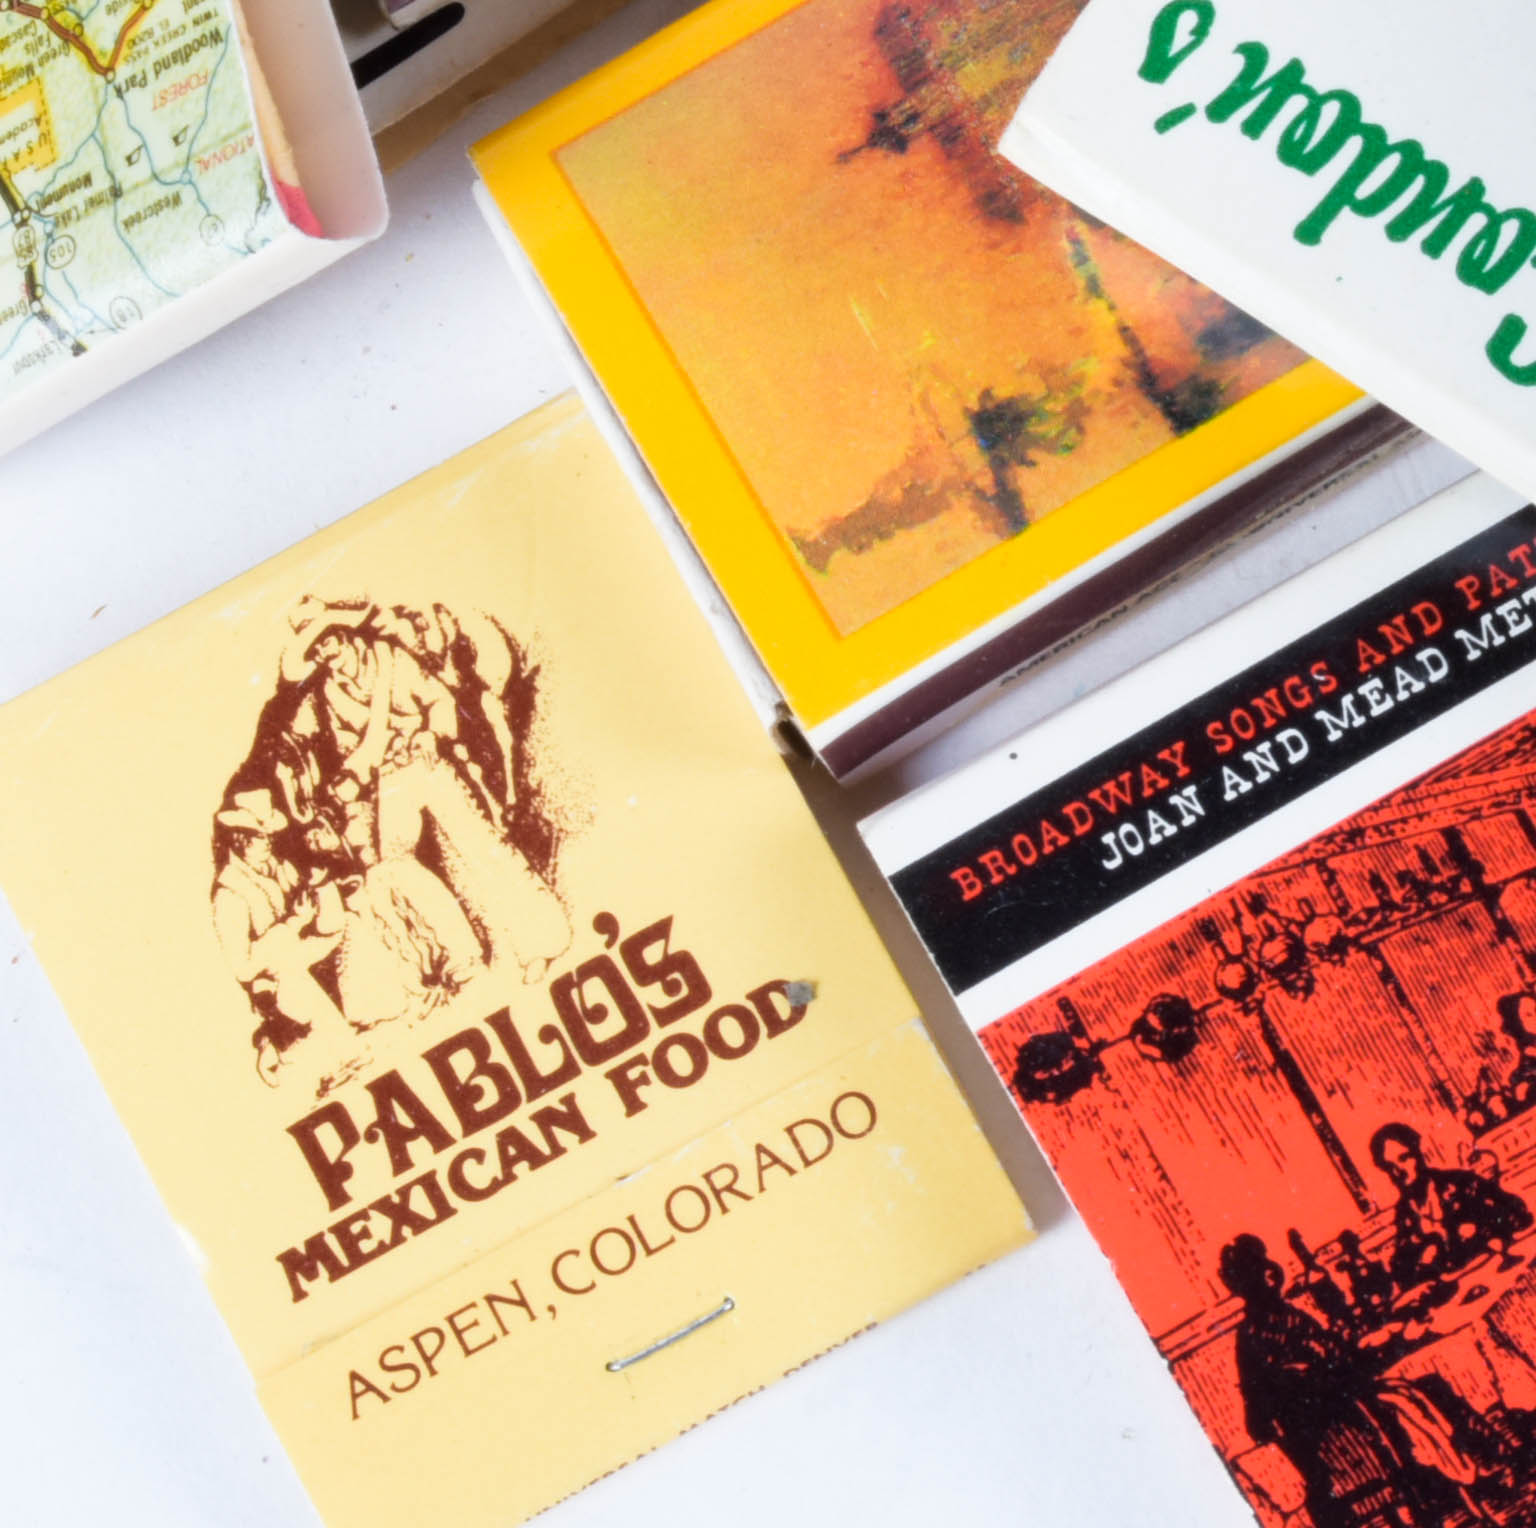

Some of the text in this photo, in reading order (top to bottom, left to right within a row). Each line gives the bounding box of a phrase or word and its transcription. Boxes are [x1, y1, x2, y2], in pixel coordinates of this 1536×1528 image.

[23, 30, 52, 60] Falls
[37, 38, 70, 71] Green
[109, 21, 222, 106] Woodland Park
[149, 65, 209, 116] FOREST
[46, 239, 73, 264] 105
[123, 186, 181, 238] Westcreek
[947, 743, 1192, 903] BROADWAY
[1205, 662, 1340, 755] SONGS
[1354, 599, 1445, 673] AND
[1097, 786, 1207, 872] JOAN
[1221, 723, 1312, 804] AND
[1320, 642, 1451, 745] MEAD
[286, 910, 714, 1213] PABLO'S
[275, 977, 811, 1304] MEXICAN FOOD
[344, 1279, 559, 1420] ASPEN,
[551, 1089, 879, 1295] COLORADO
